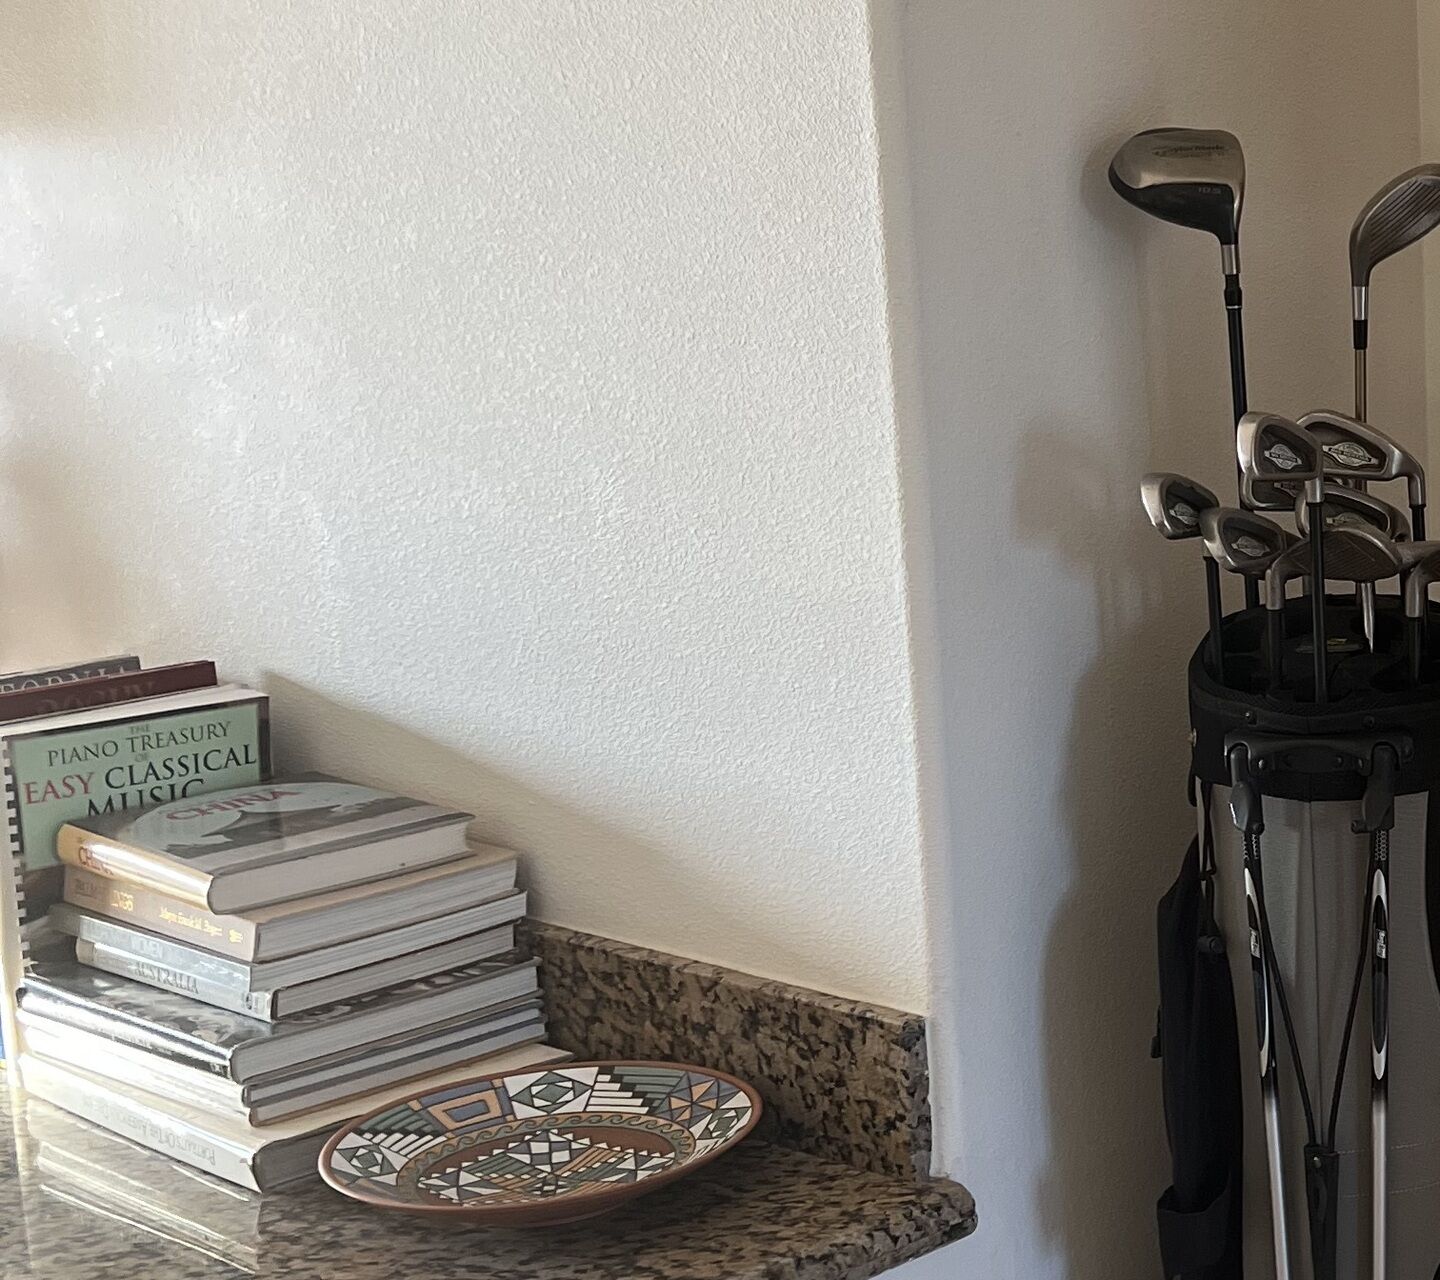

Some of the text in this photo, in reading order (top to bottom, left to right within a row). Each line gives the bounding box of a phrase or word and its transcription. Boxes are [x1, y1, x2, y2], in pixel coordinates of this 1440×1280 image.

[48, 721, 231, 767] PIANO TREASURY
[23, 744, 257, 805] EASY CLASSICAL
[167, 789, 301, 820] CHINA
